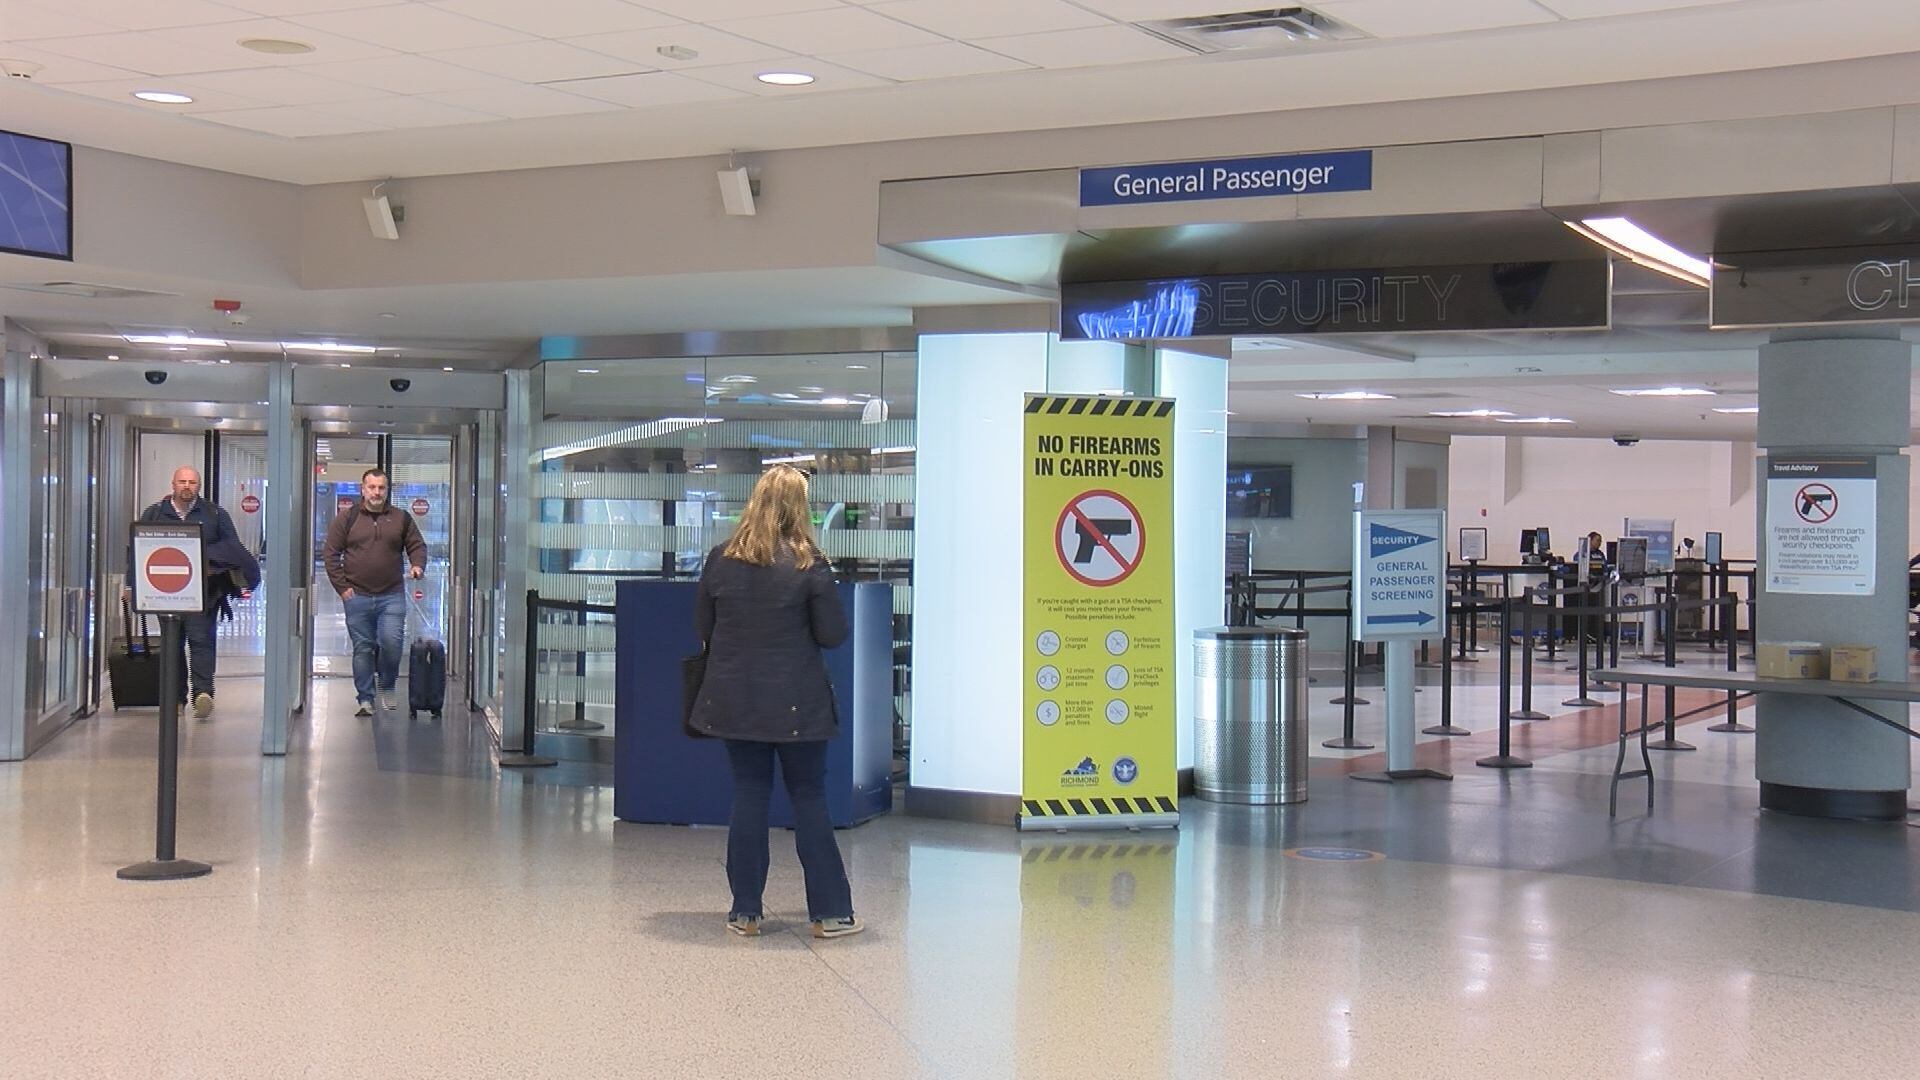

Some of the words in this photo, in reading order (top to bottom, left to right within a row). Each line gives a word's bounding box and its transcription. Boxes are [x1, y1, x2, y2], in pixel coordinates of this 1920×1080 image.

[1113, 168, 1204, 197] General
[1213, 164, 1334, 192] Passenger
[1194, 274, 1461, 328] SECURITY
[1038, 435, 1063, 453] NO
[1070, 436, 1161, 456] FIREARMS
[1035, 457, 1053, 476] IN
[1060, 458, 1164, 479] CARRY-ONS
[1372, 535, 1419, 545] SECURITY
[1831, 534, 1860, 542] through
[1376, 561, 1428, 572] GENERAL
[1370, 576, 1435, 586] PASSENGER
[1371, 590, 1434, 601] SCREENING
